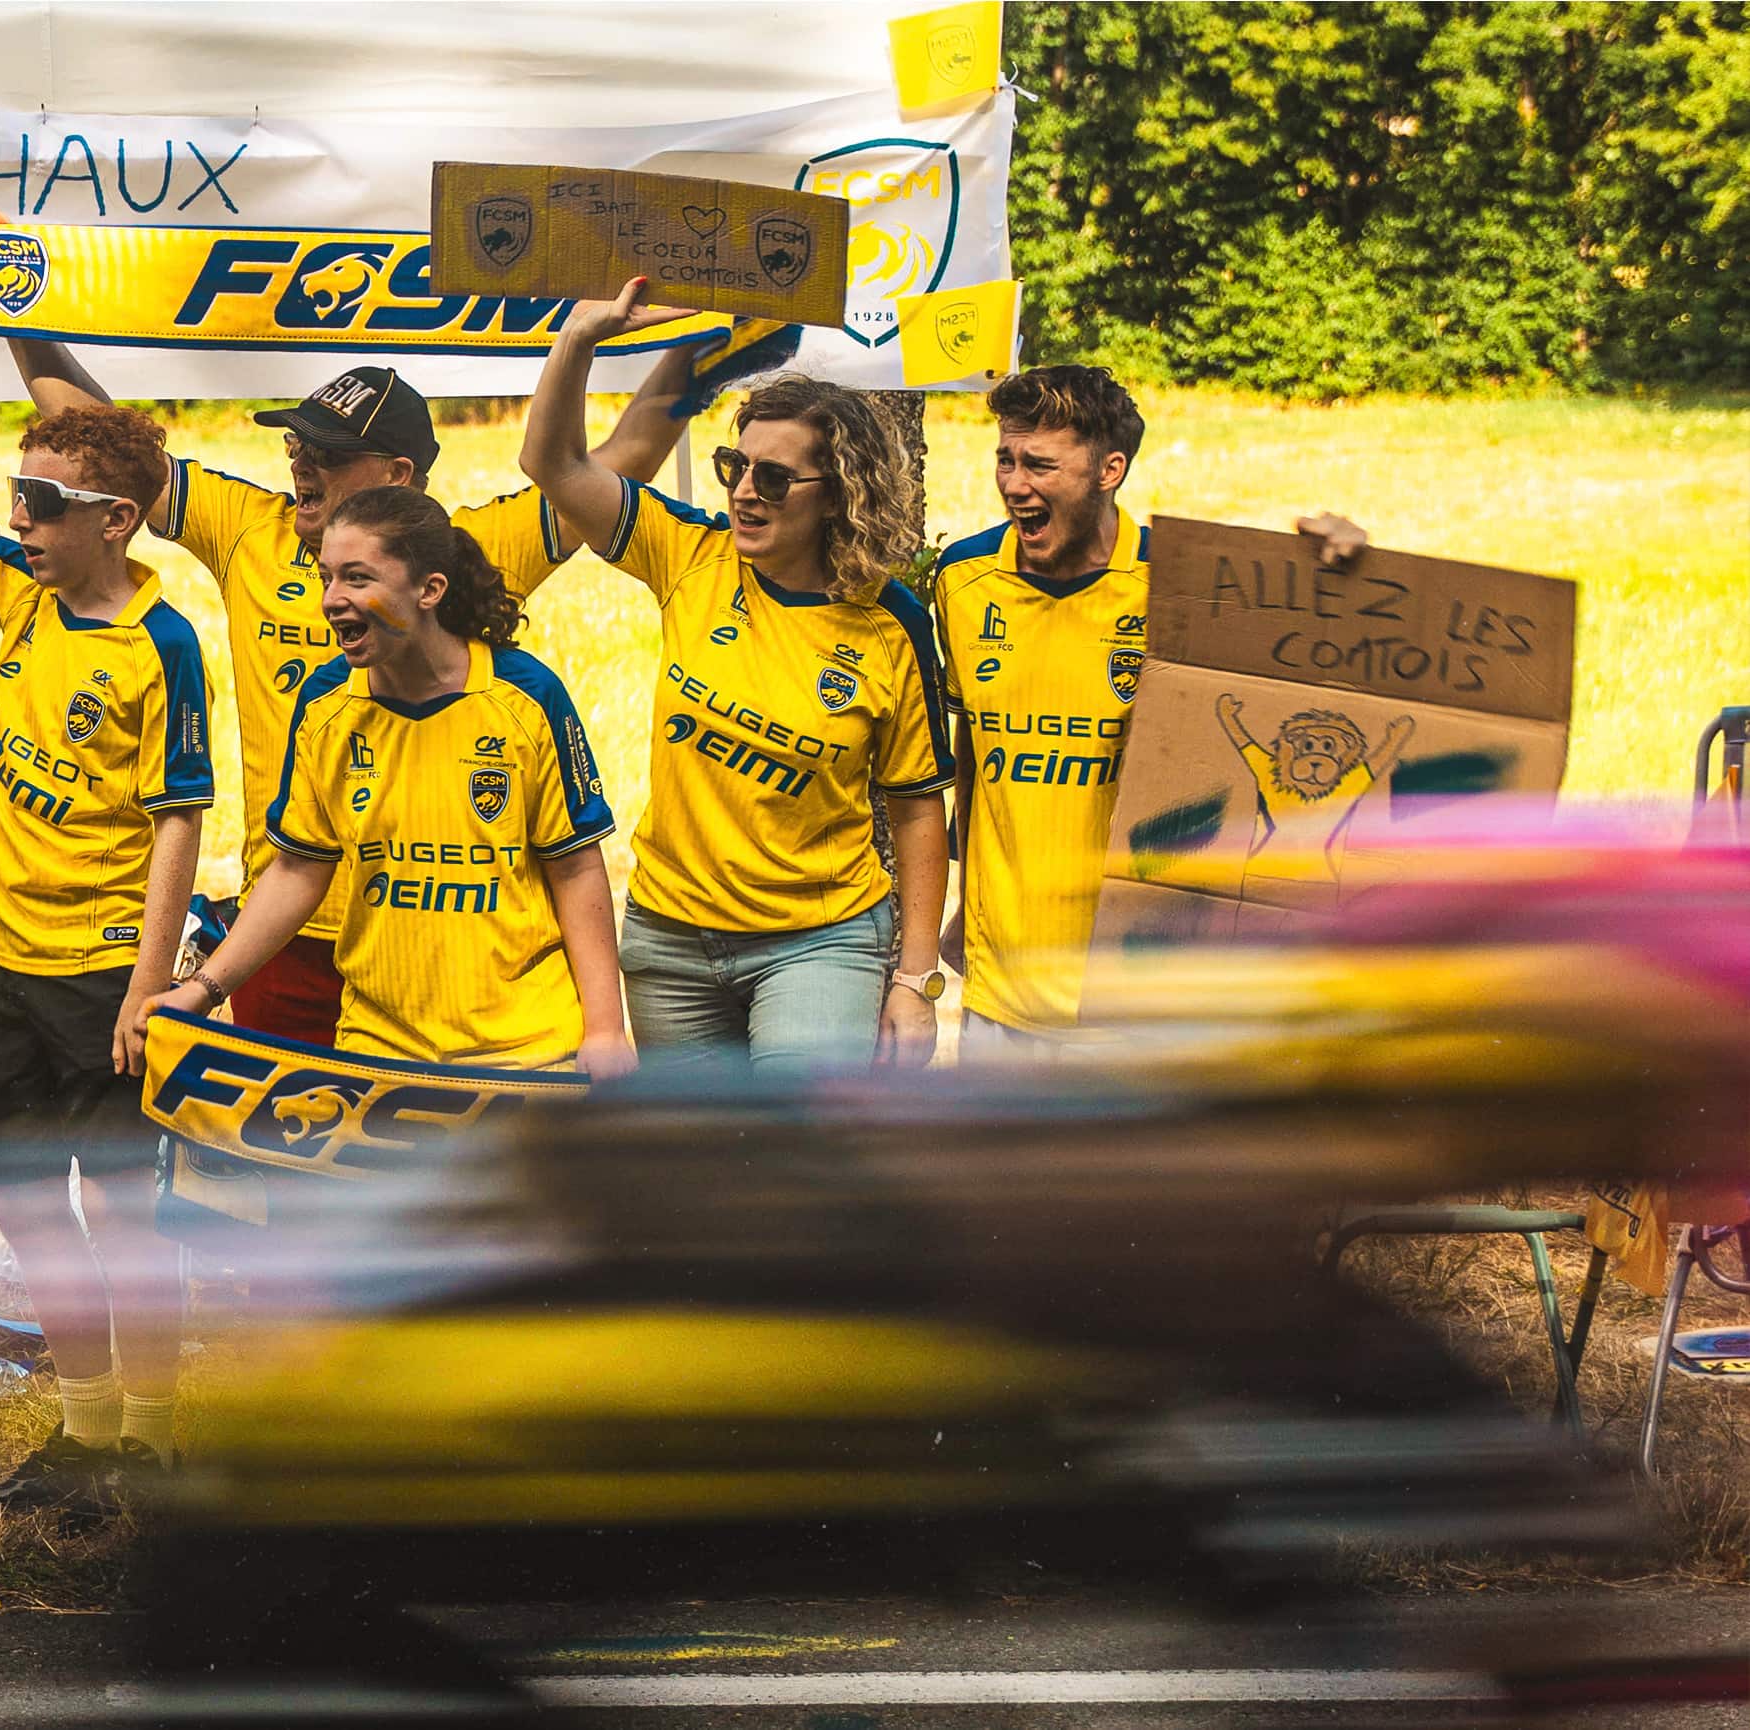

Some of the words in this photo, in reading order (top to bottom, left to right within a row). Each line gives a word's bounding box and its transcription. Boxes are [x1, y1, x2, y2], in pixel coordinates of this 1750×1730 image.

[550, 183, 604, 199] ICI
[812, 166, 941, 207] FCSM
[483, 209, 527, 222] FCSM
[593, 200, 637, 215] BAT
[618, 222, 648, 237] LE
[761, 228, 806, 246] FCSM
[634, 242, 718, 261] COEUR
[173, 240, 575, 332] FCS
[659, 266, 760, 289] COMTOIS
[853, 311, 895, 323] 1928
[1211, 555, 1411, 620] ALLEZ
[1447, 598, 1536, 655] LES
[1272, 631, 1490, 692] COMTOIS
[75, 695, 102, 714] FCSM
[666, 662, 850, 764] PEUGEOT
[966, 710, 1124, 739] PEUGEO
[474, 775, 506, 787] FCSM
[152, 1043, 528, 1172] FCS
